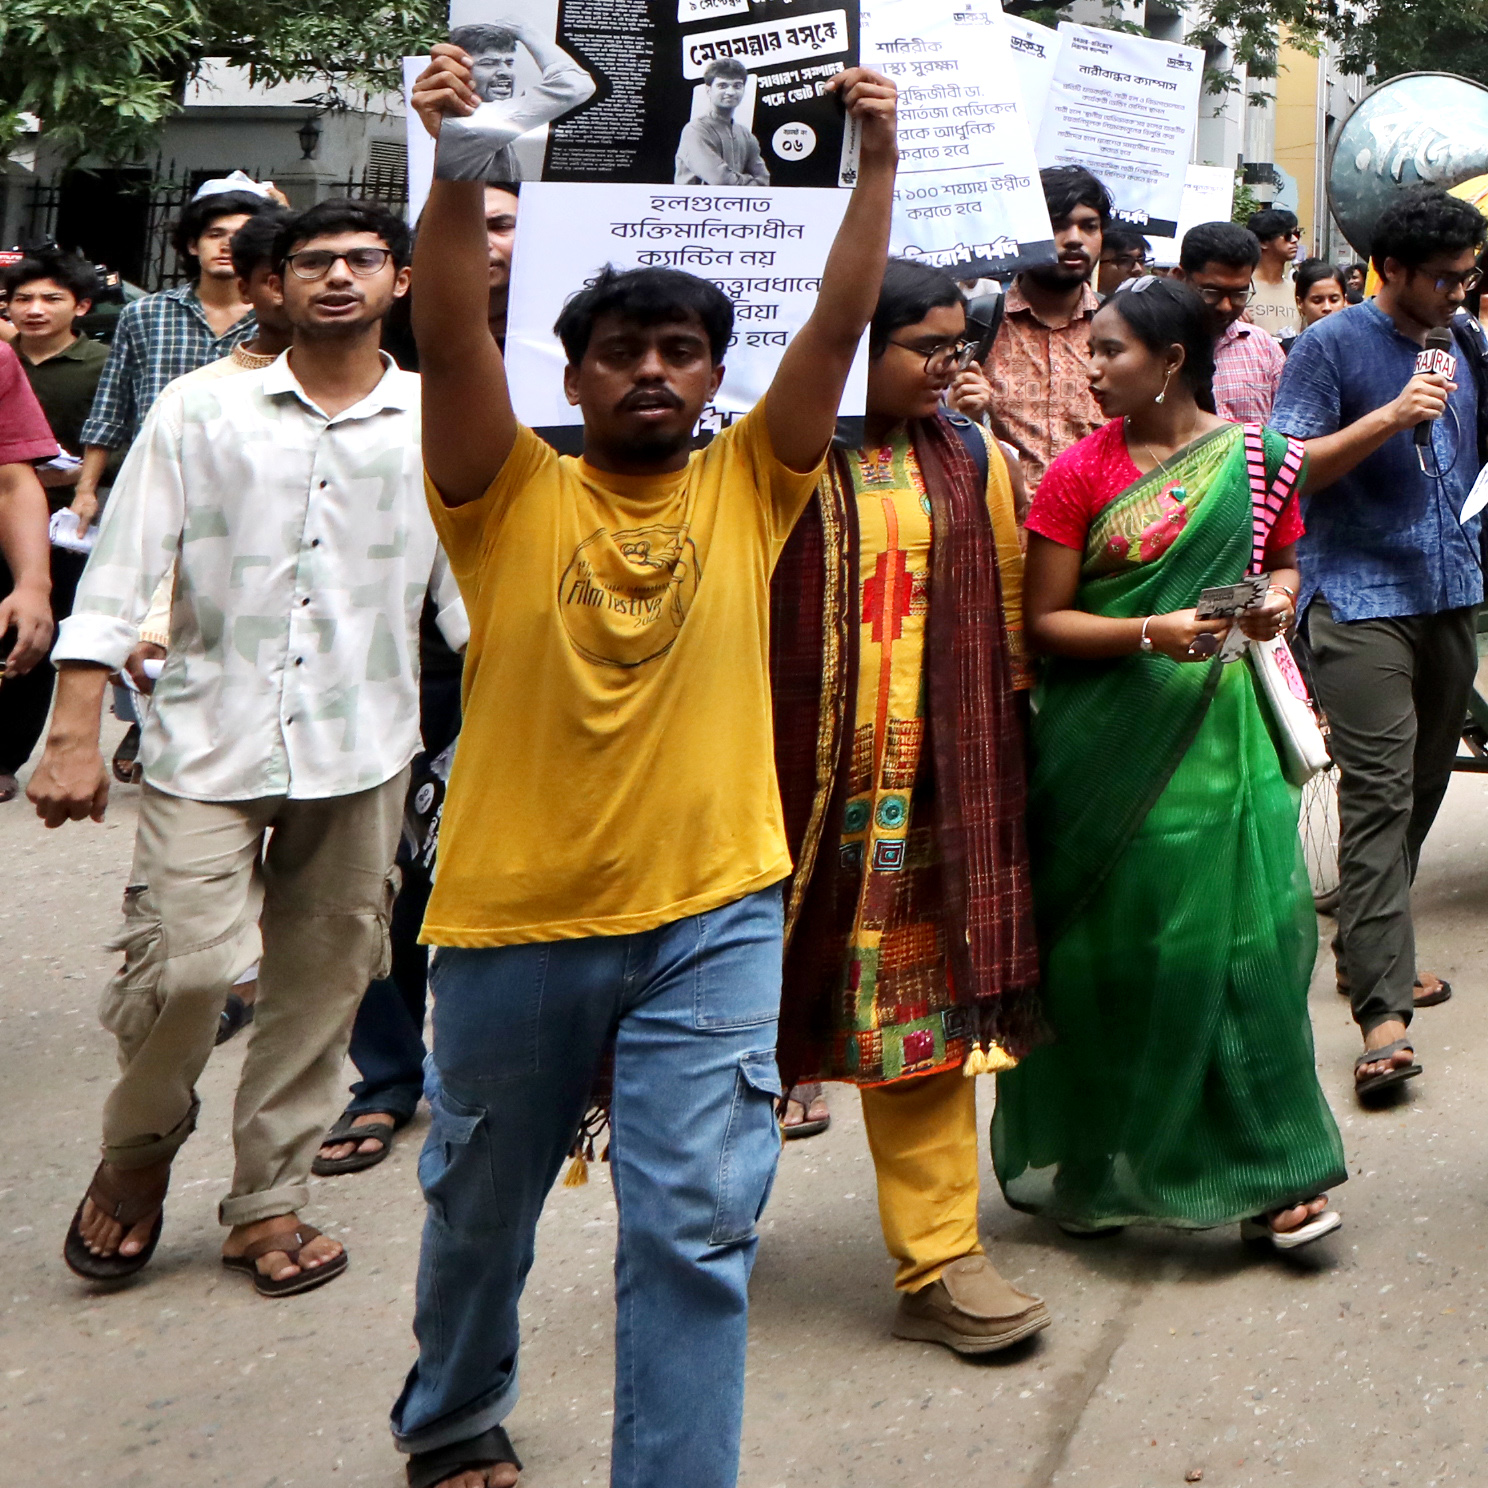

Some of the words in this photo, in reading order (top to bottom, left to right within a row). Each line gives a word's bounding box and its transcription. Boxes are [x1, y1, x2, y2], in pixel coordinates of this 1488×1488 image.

[953, 12, 994, 25] ডাকসু
[690, 31, 782, 66] মেঘমল্লার
[785, 22, 838, 50] বসুকে
[1010, 35, 1046, 59] ডাকসু
[909, 60, 959, 76] সুরক্ষা
[1079, 64, 1131, 82] নারীবান্ধব
[1133, 75, 1177, 91] ক্যাম্পাস
[757, 71, 800, 89] সাধারণ
[762, 93, 786, 107] পদে
[788, 85, 814, 103] ভোট
[897, 83, 961, 105] বুদ্ধিজীবী
[963, 86, 984, 97] ডা.
[952, 101, 1017, 116] মেডিকেল
[932, 121, 995, 140] আধুনিক
[782, 139, 803, 152] ০৬
[898, 147, 940, 160] করতে
[942, 144, 970, 157] হবে
[904, 187, 938, 201] ১০০
[941, 181, 988, 195] শয্যায়
[990, 173, 1030, 191] উন্নীত
[650, 195, 772, 212] হলগুলোত
[905, 205, 952, 220] করতে
[954, 201, 982, 215] হবে
[610, 217, 805, 239] ব্যক্তিমালিকাধীন
[637, 245, 734, 266] ক্যান্টিন
[739, 251, 776, 268] নয়
[1245, 304, 1296, 318] ESPRIT
[746, 331, 788, 347] হবে
[1435, 352, 1456, 377] RAJ
[567, 579, 604, 607] Film
